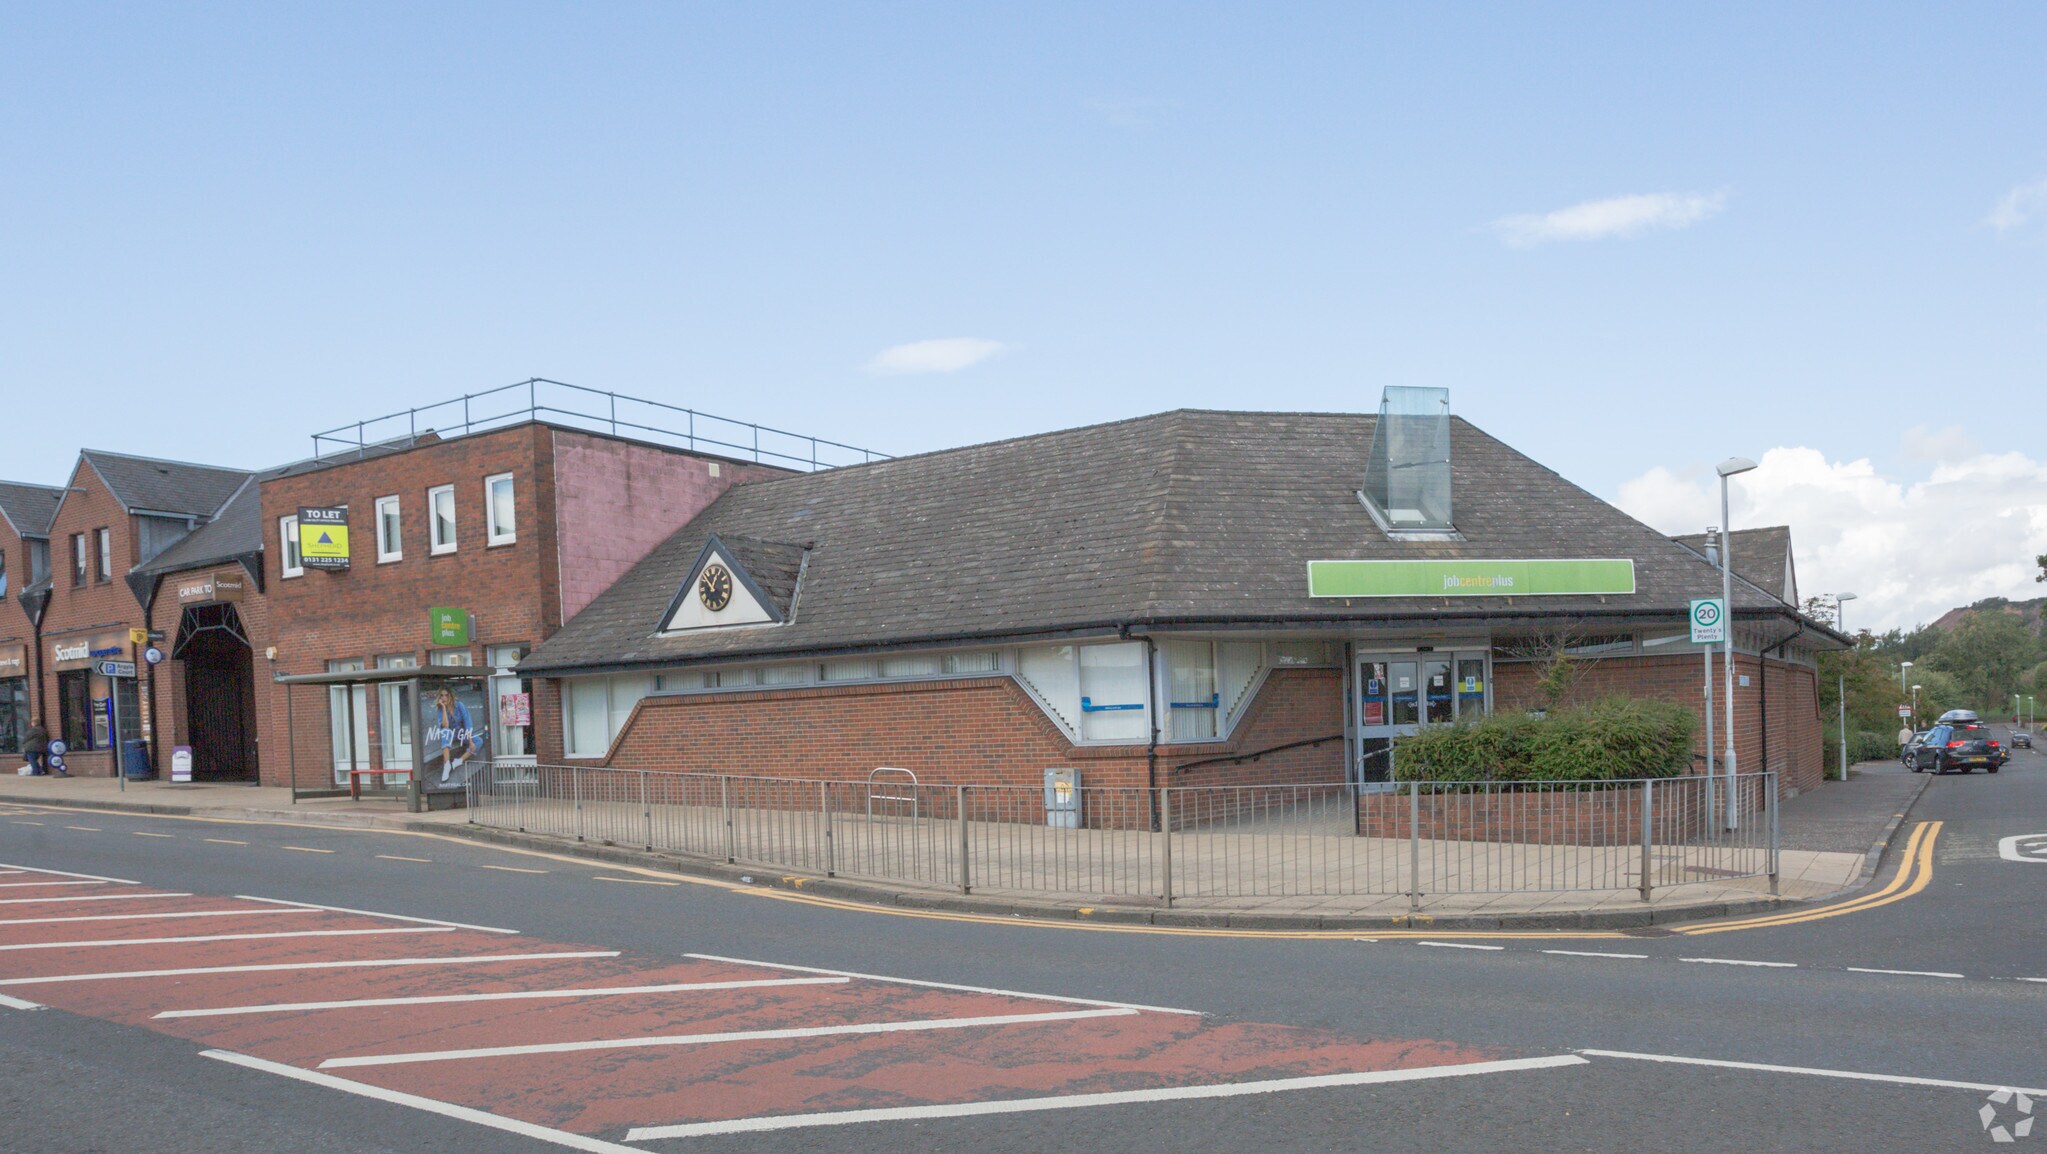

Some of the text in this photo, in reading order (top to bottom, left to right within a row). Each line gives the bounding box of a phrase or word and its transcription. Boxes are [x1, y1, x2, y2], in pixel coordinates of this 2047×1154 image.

[306, 510, 341, 519] TO LET
[180, 584, 213, 597] CAR PARK TO
[216, 581, 242, 589] Scotmid
[441, 613, 452, 624] job
[1698, 608, 1716, 619] 20
[441, 629, 455, 638] plus
[1693, 627, 1722, 635] Twenty's
[55, 641, 90, 661] Scotmid
[425, 725, 484, 747] NASTY GAL
